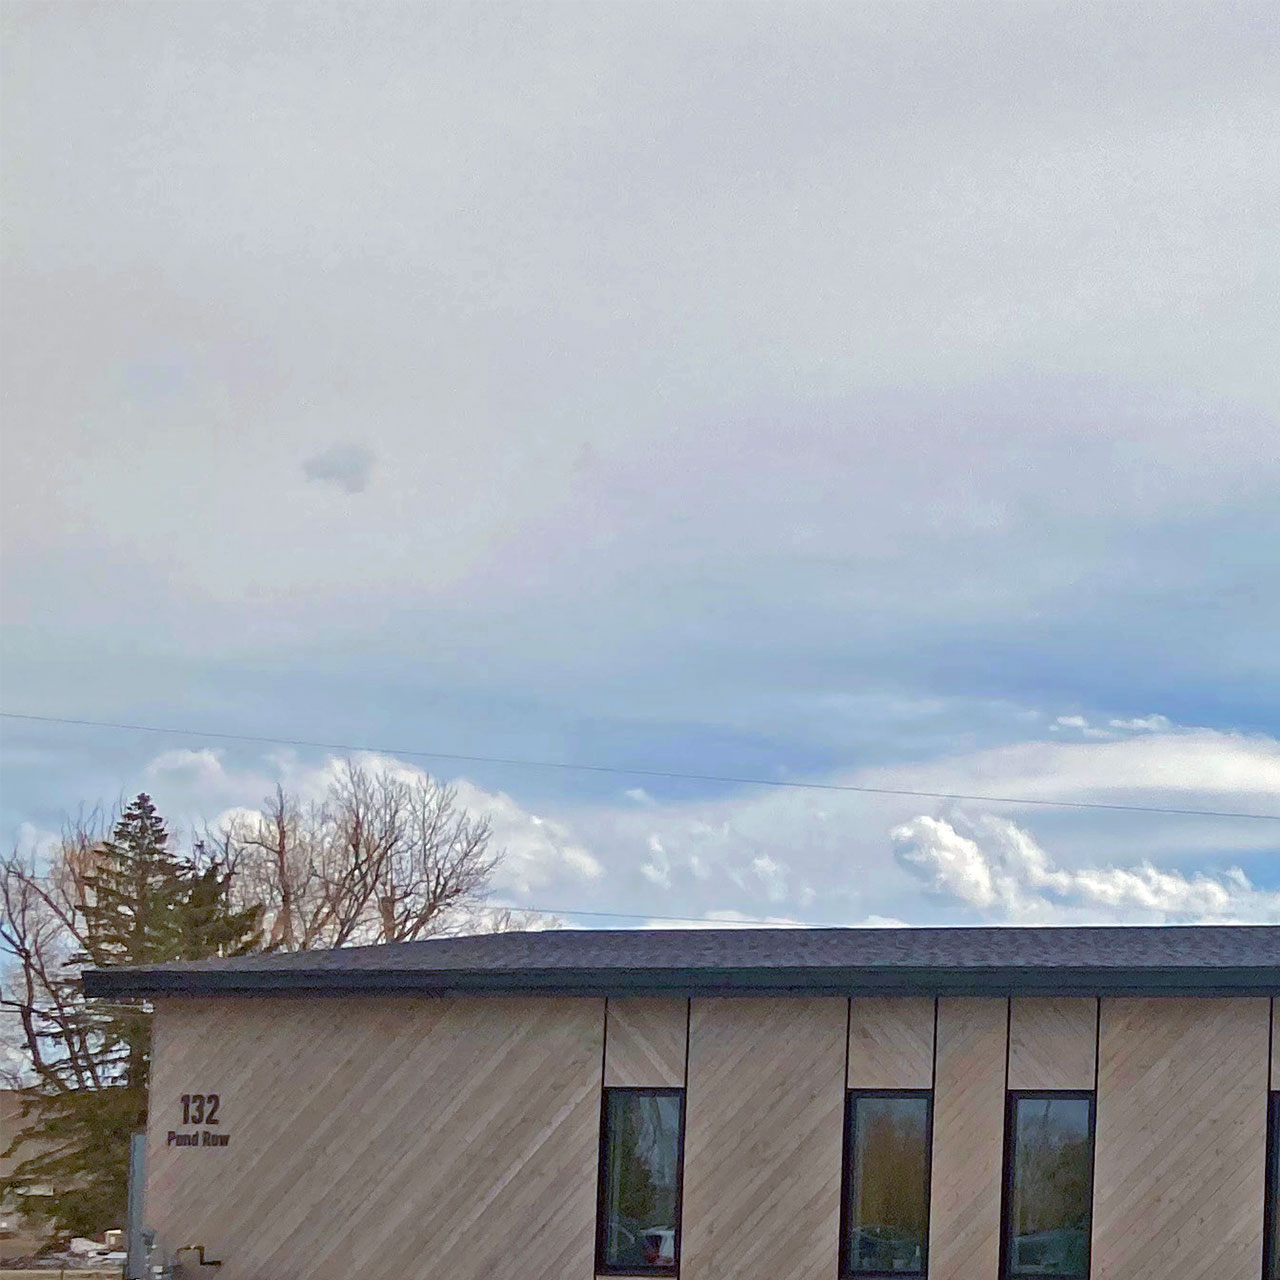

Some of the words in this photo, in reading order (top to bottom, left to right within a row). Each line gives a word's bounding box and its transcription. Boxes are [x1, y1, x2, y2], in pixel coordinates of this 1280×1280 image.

[181, 1094, 220, 1125] 132
[167, 1130, 199, 1146] Pond
[202, 1130, 231, 1146] Row
